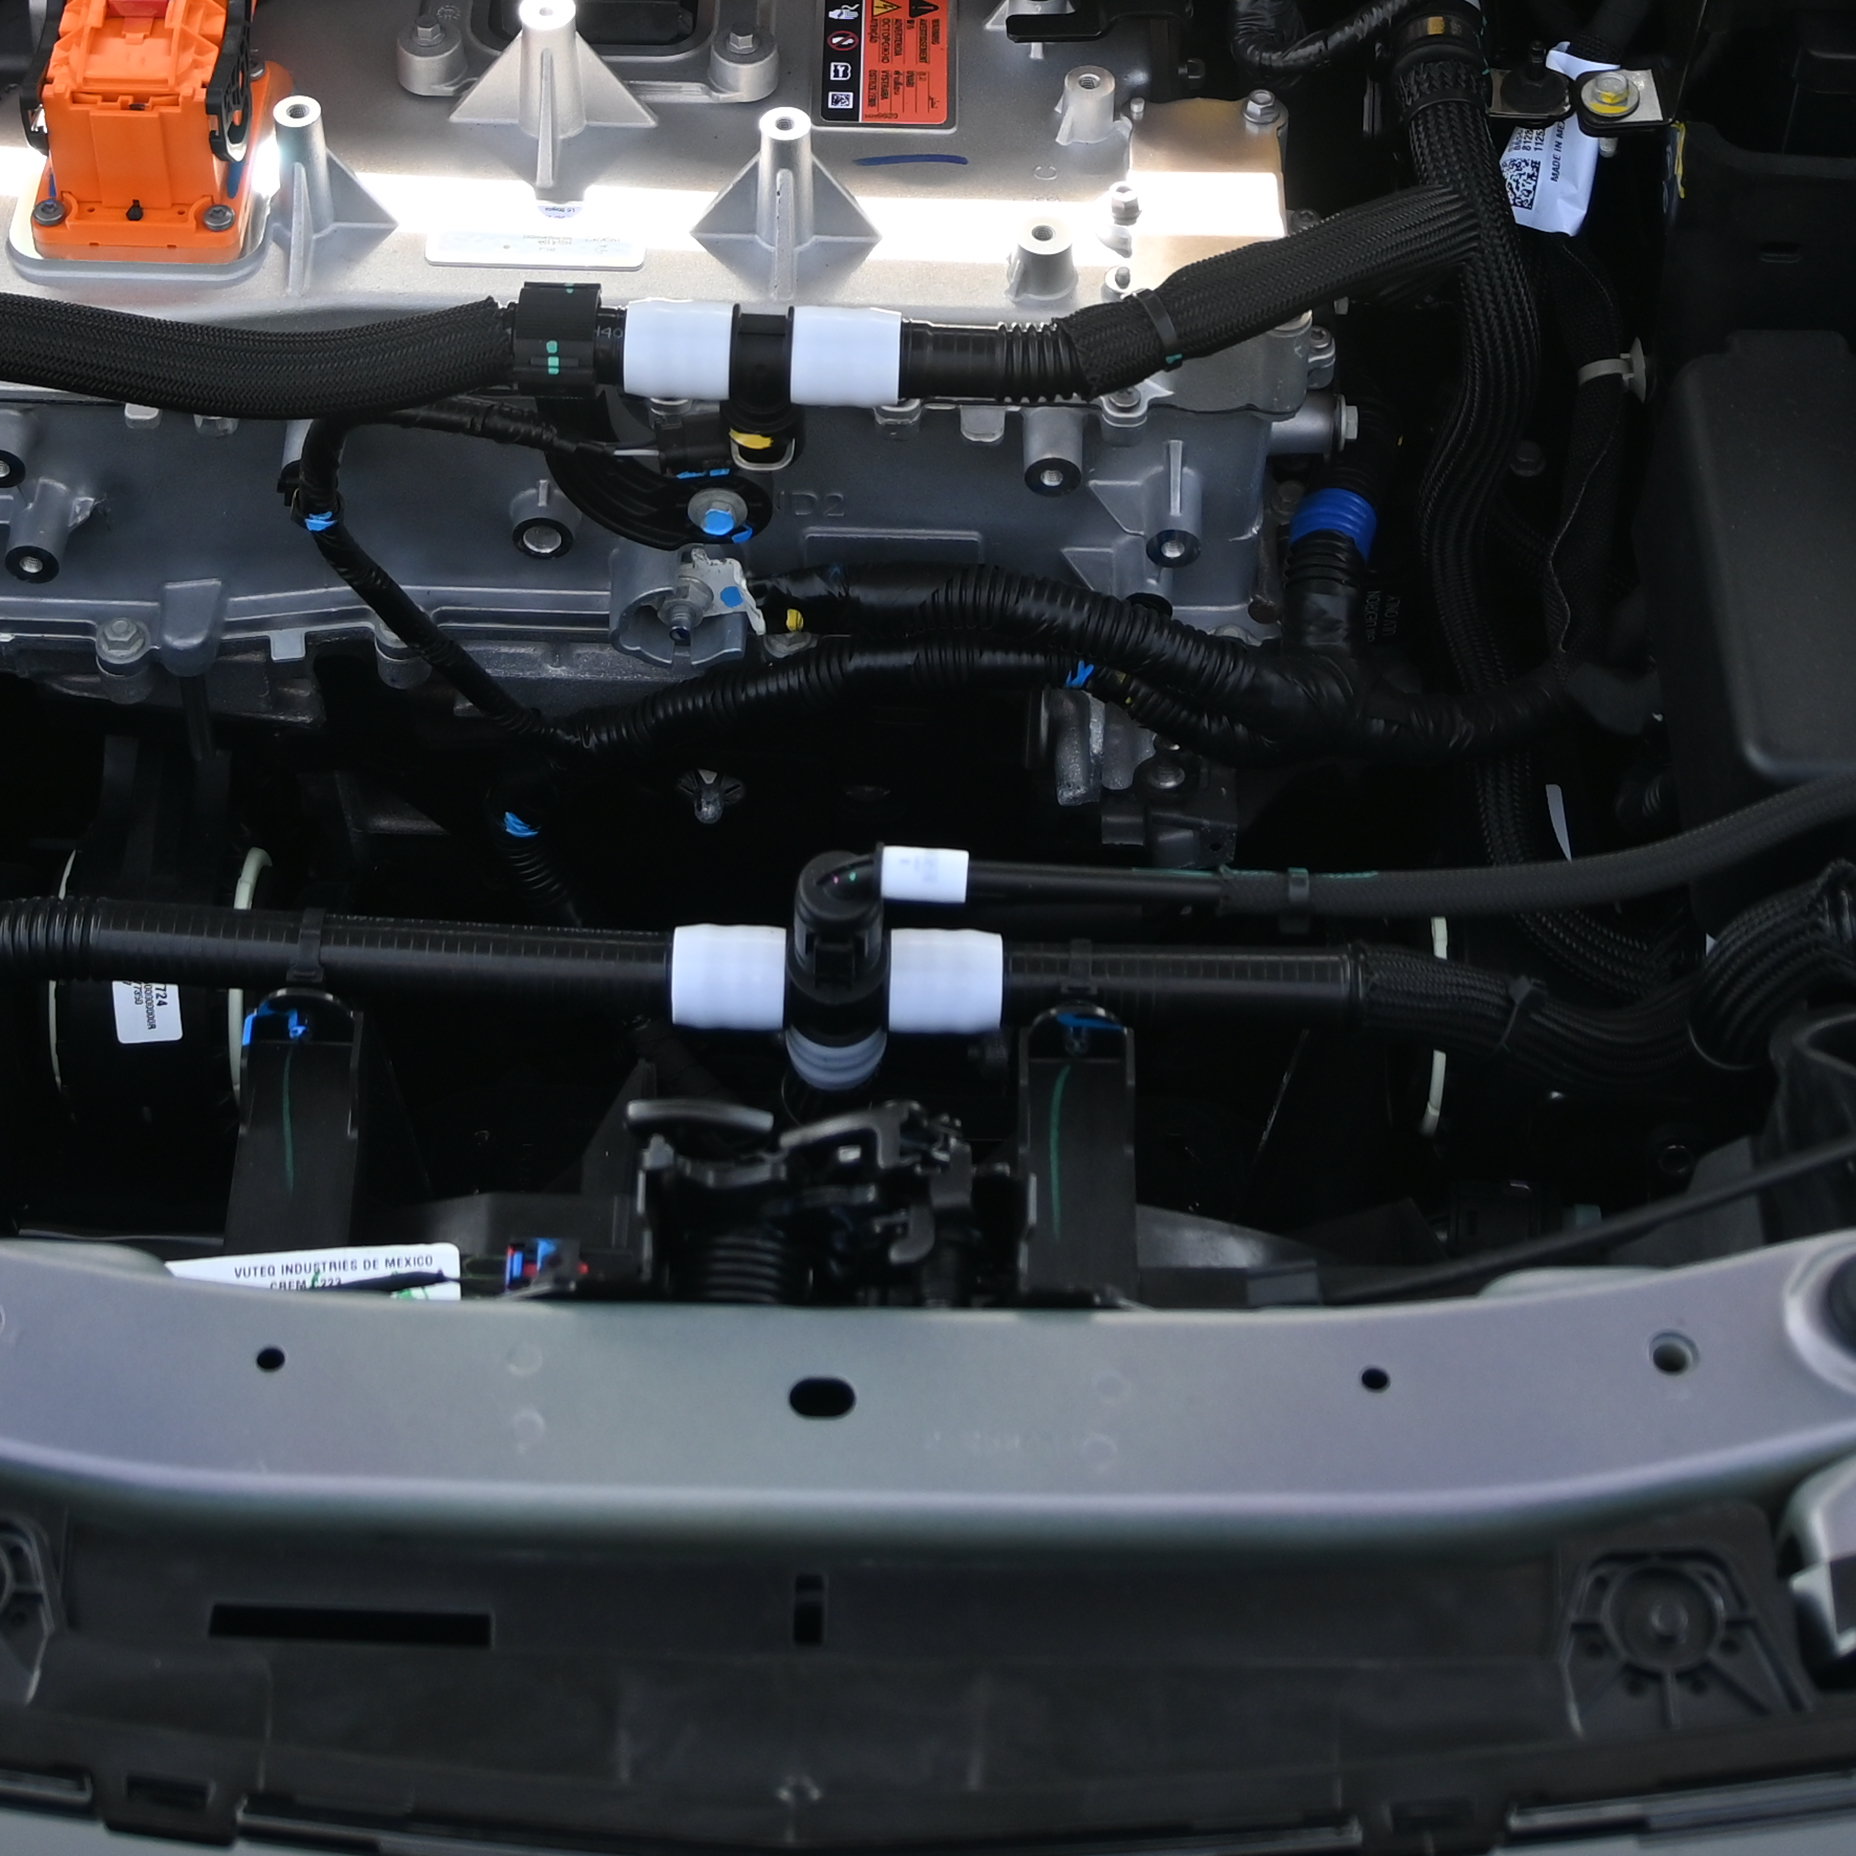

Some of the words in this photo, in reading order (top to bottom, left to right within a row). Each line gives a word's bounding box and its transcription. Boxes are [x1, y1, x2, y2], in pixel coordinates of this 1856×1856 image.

[1555, 141, 1564, 153] IN
[1550, 155, 1562, 182] MADE
[281, 1260, 357, 1276] INDUSTRIES
[362, 1259, 379, 1271] DE
[384, 1254, 434, 1269] MEXICO
